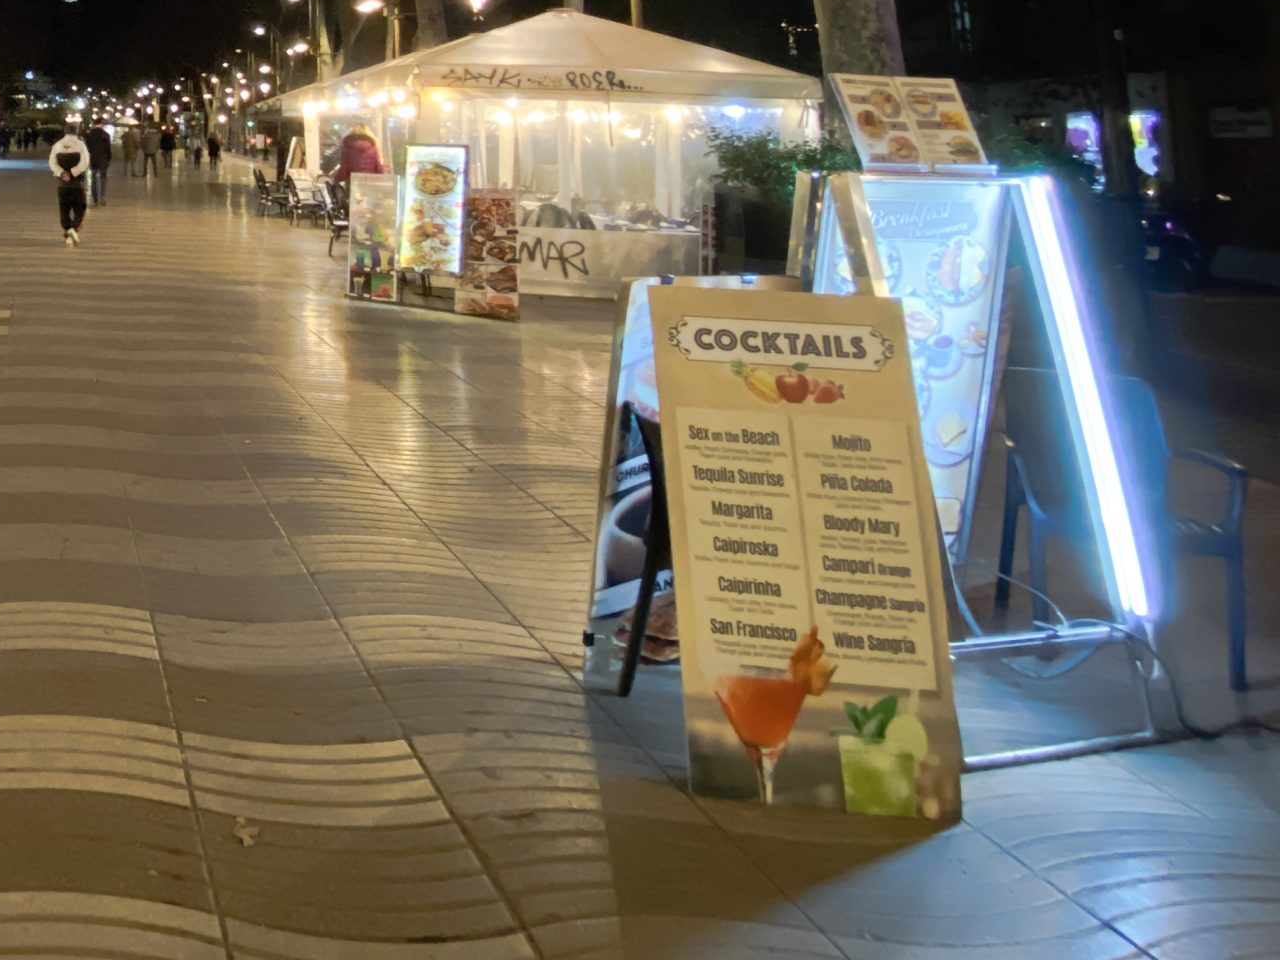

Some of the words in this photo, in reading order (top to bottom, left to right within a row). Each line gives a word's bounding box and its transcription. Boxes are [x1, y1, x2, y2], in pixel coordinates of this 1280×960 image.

[694, 327, 867, 360] COCKTAILS
[688, 425, 710, 441] Sex
[712, 431, 723, 442] on
[725, 431, 740, 443] the
[741, 429, 780, 446] Beach
[832, 434, 872, 452] Mojito
[692, 465, 736, 484] Tequila
[737, 468, 785, 487] Sunrise
[820, 473, 849, 491] Piña
[850, 475, 894, 494] Colada
[711, 500, 773, 520] Margarita
[823, 514, 865, 535] Bloody
[867, 517, 900, 538] Mary
[713, 536, 779, 557] Caipiroska
[822, 555, 876, 575] Campari
[718, 576, 782, 597] Caipirinha
[815, 588, 888, 610] Champagne
[710, 618, 734, 636] San
[736, 620, 798, 642] Francisco
[832, 631, 865, 650] Wine
